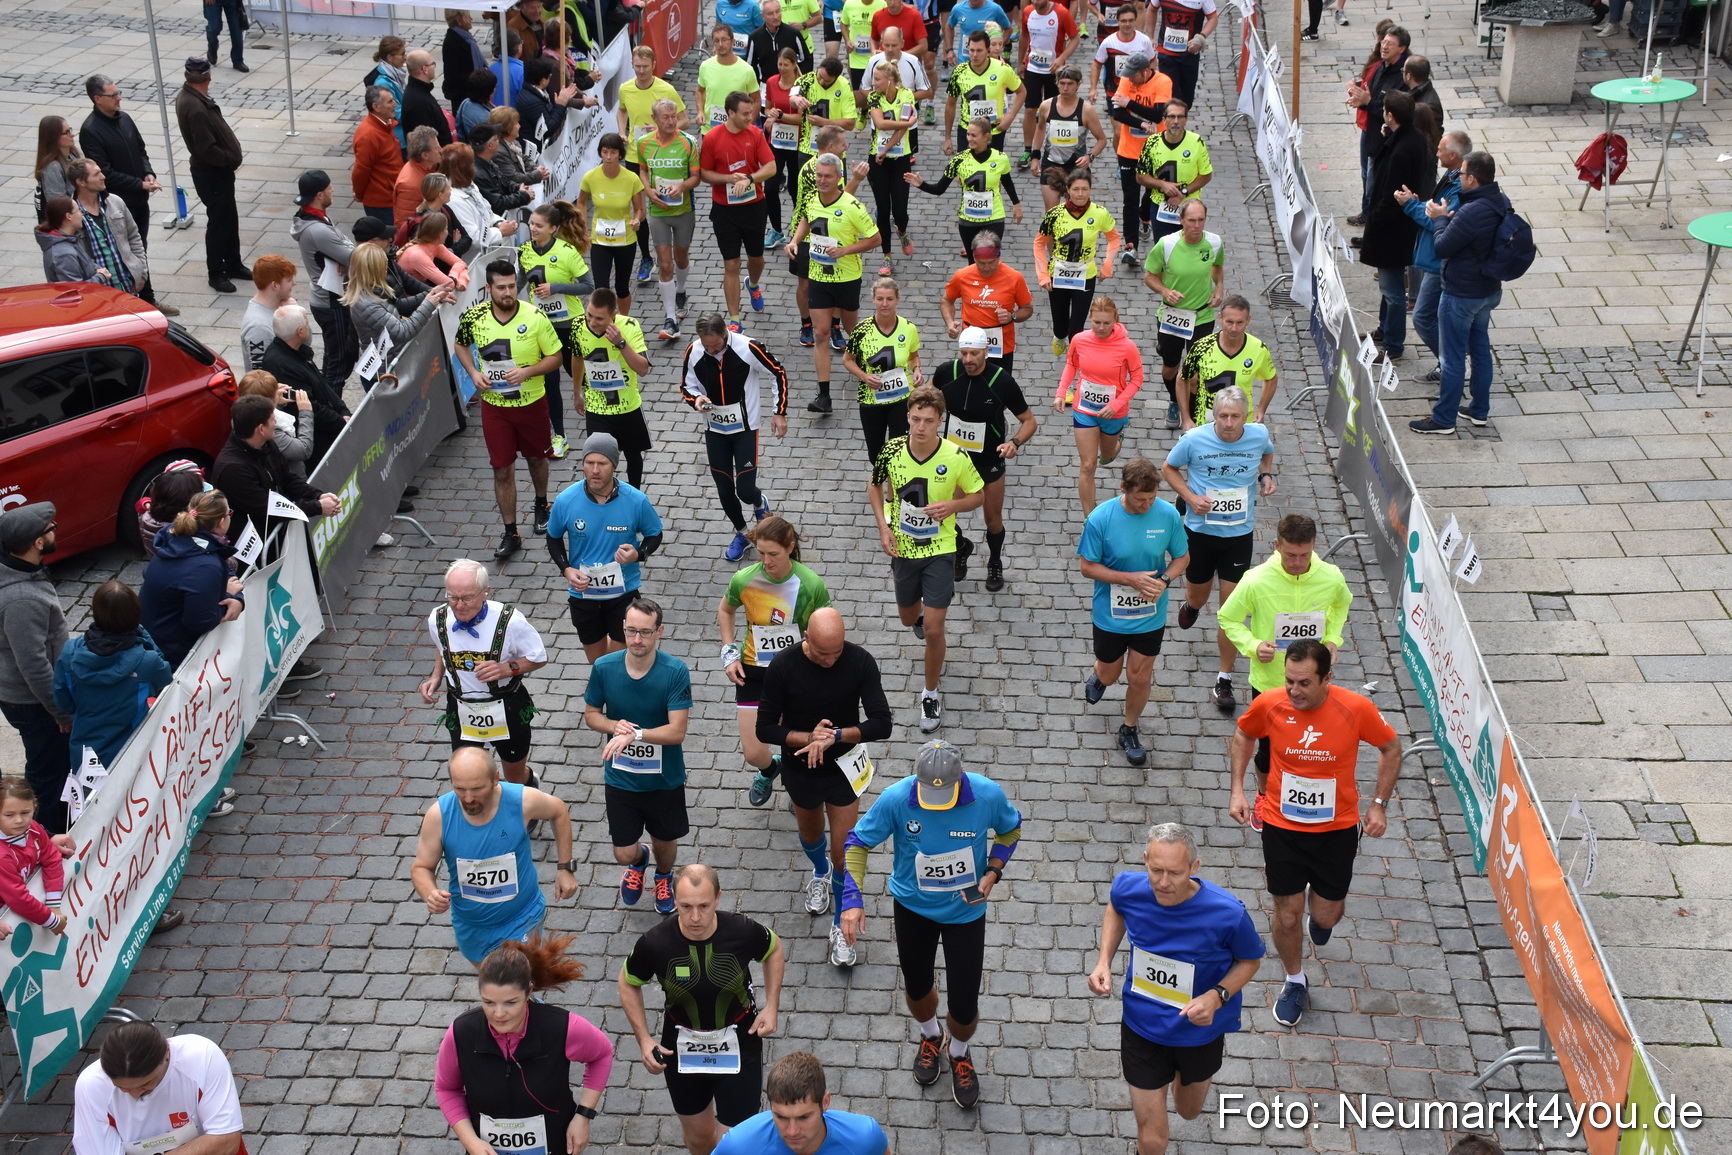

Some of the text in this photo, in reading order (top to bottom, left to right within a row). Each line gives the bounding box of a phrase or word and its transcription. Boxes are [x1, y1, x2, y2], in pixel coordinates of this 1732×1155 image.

[1167, 36, 1185, 44] 2783
[1031, 55, 1048, 63] 2241
[713, 112, 728, 121] 238
[974, 107, 994, 116] 2682
[775, 132, 794, 140] 2012
[1056, 129, 1071, 137] 103
[647, 159, 683, 168] BOCK
[968, 199, 988, 208] 2684
[1163, 203, 1181, 212] 267
[605, 228, 616, 237] 87
[813, 244, 827, 254] 267
[1058, 269, 1082, 278] 2677
[538, 300, 563, 312] 2660
[1166, 315, 1191, 328] 2276
[988, 338, 999, 346] 90
[361, 356, 377, 374] swn
[592, 370, 618, 381] 2672
[877, 377, 904, 392] 2676
[1085, 391, 1110, 404] 2356
[711, 413, 738, 424] 2943
[955, 428, 976, 441] 416
[275, 501, 296, 511] swn
[1211, 500, 1243, 512] 2365
[904, 513, 934, 527] 2674
[241, 535, 257, 558] swn
[1463, 554, 1479, 578] swn
[588, 574, 616, 587] 2147
[1117, 595, 1148, 607] 2454
[1281, 624, 1318, 638] 2468
[760, 635, 795, 650] 2169
[468, 714, 494, 727] 220
[621, 745, 655, 758] 2569
[1285, 747, 1330, 757] funrunners
[1288, 789, 1325, 806] 2641
[924, 861, 967, 878] 2513
[466, 869, 509, 886] 2570
[121, 889, 169, 969] Service-Line:
[1552, 921, 1575, 969] Neumarkts
[1146, 967, 1178, 988] 304
[685, 1041, 730, 1054] 2254
[488, 1132, 537, 1148] 2606
